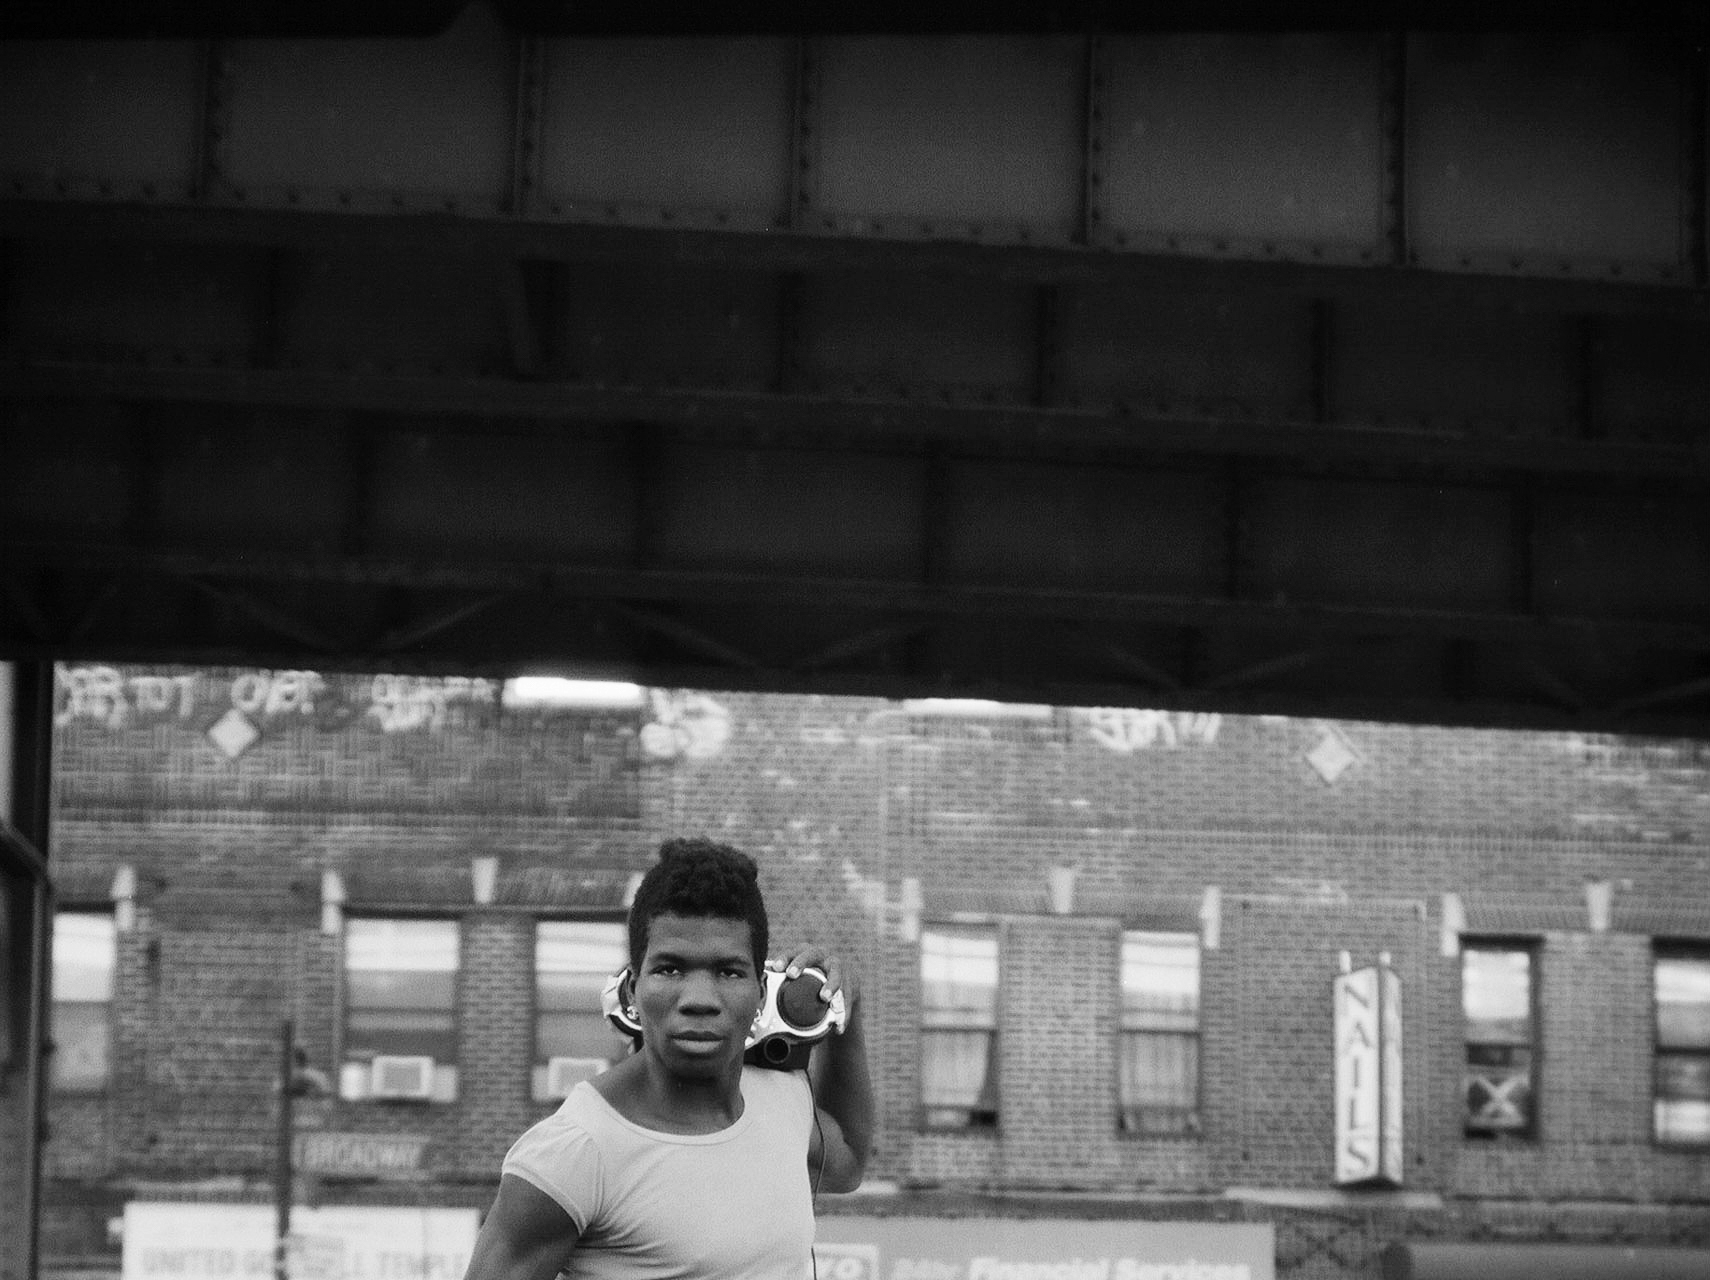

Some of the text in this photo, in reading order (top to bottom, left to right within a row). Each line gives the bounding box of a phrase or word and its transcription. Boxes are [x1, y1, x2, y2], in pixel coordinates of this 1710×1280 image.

[1338, 981, 1376, 1174] NAILS
[142, 1248, 236, 1275] UNITED
[376, 1252, 467, 1280] TEMPLE
